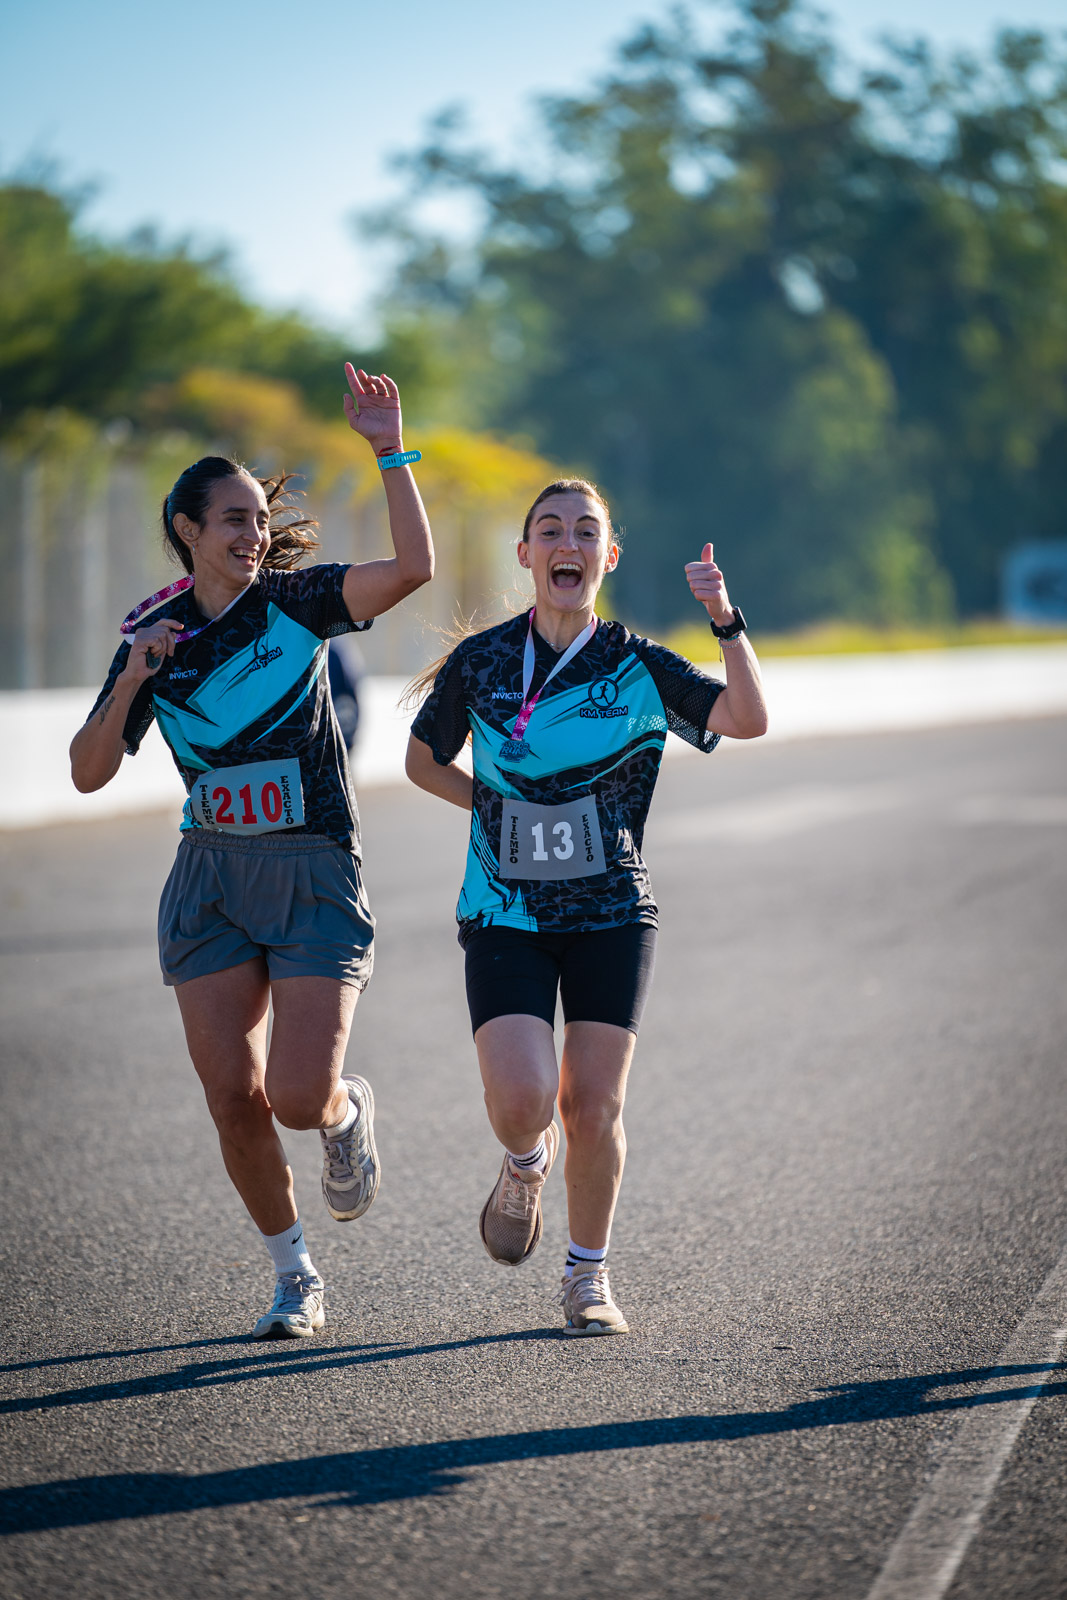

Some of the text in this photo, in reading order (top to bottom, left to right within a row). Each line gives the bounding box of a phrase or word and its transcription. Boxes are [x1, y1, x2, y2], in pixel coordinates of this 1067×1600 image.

[169, 668, 198, 680] INVICTO
[491, 692, 524, 700] INVICTO
[599, 706, 628, 718] TEAM
[200, 784, 215, 825] TIEMPO
[212, 781, 283, 825] 210
[280, 775, 295, 825] EXACTO
[509, 815, 519, 864] TIEMPO
[531, 821, 575, 861] 13
[581, 813, 594, 863] EXACTO
